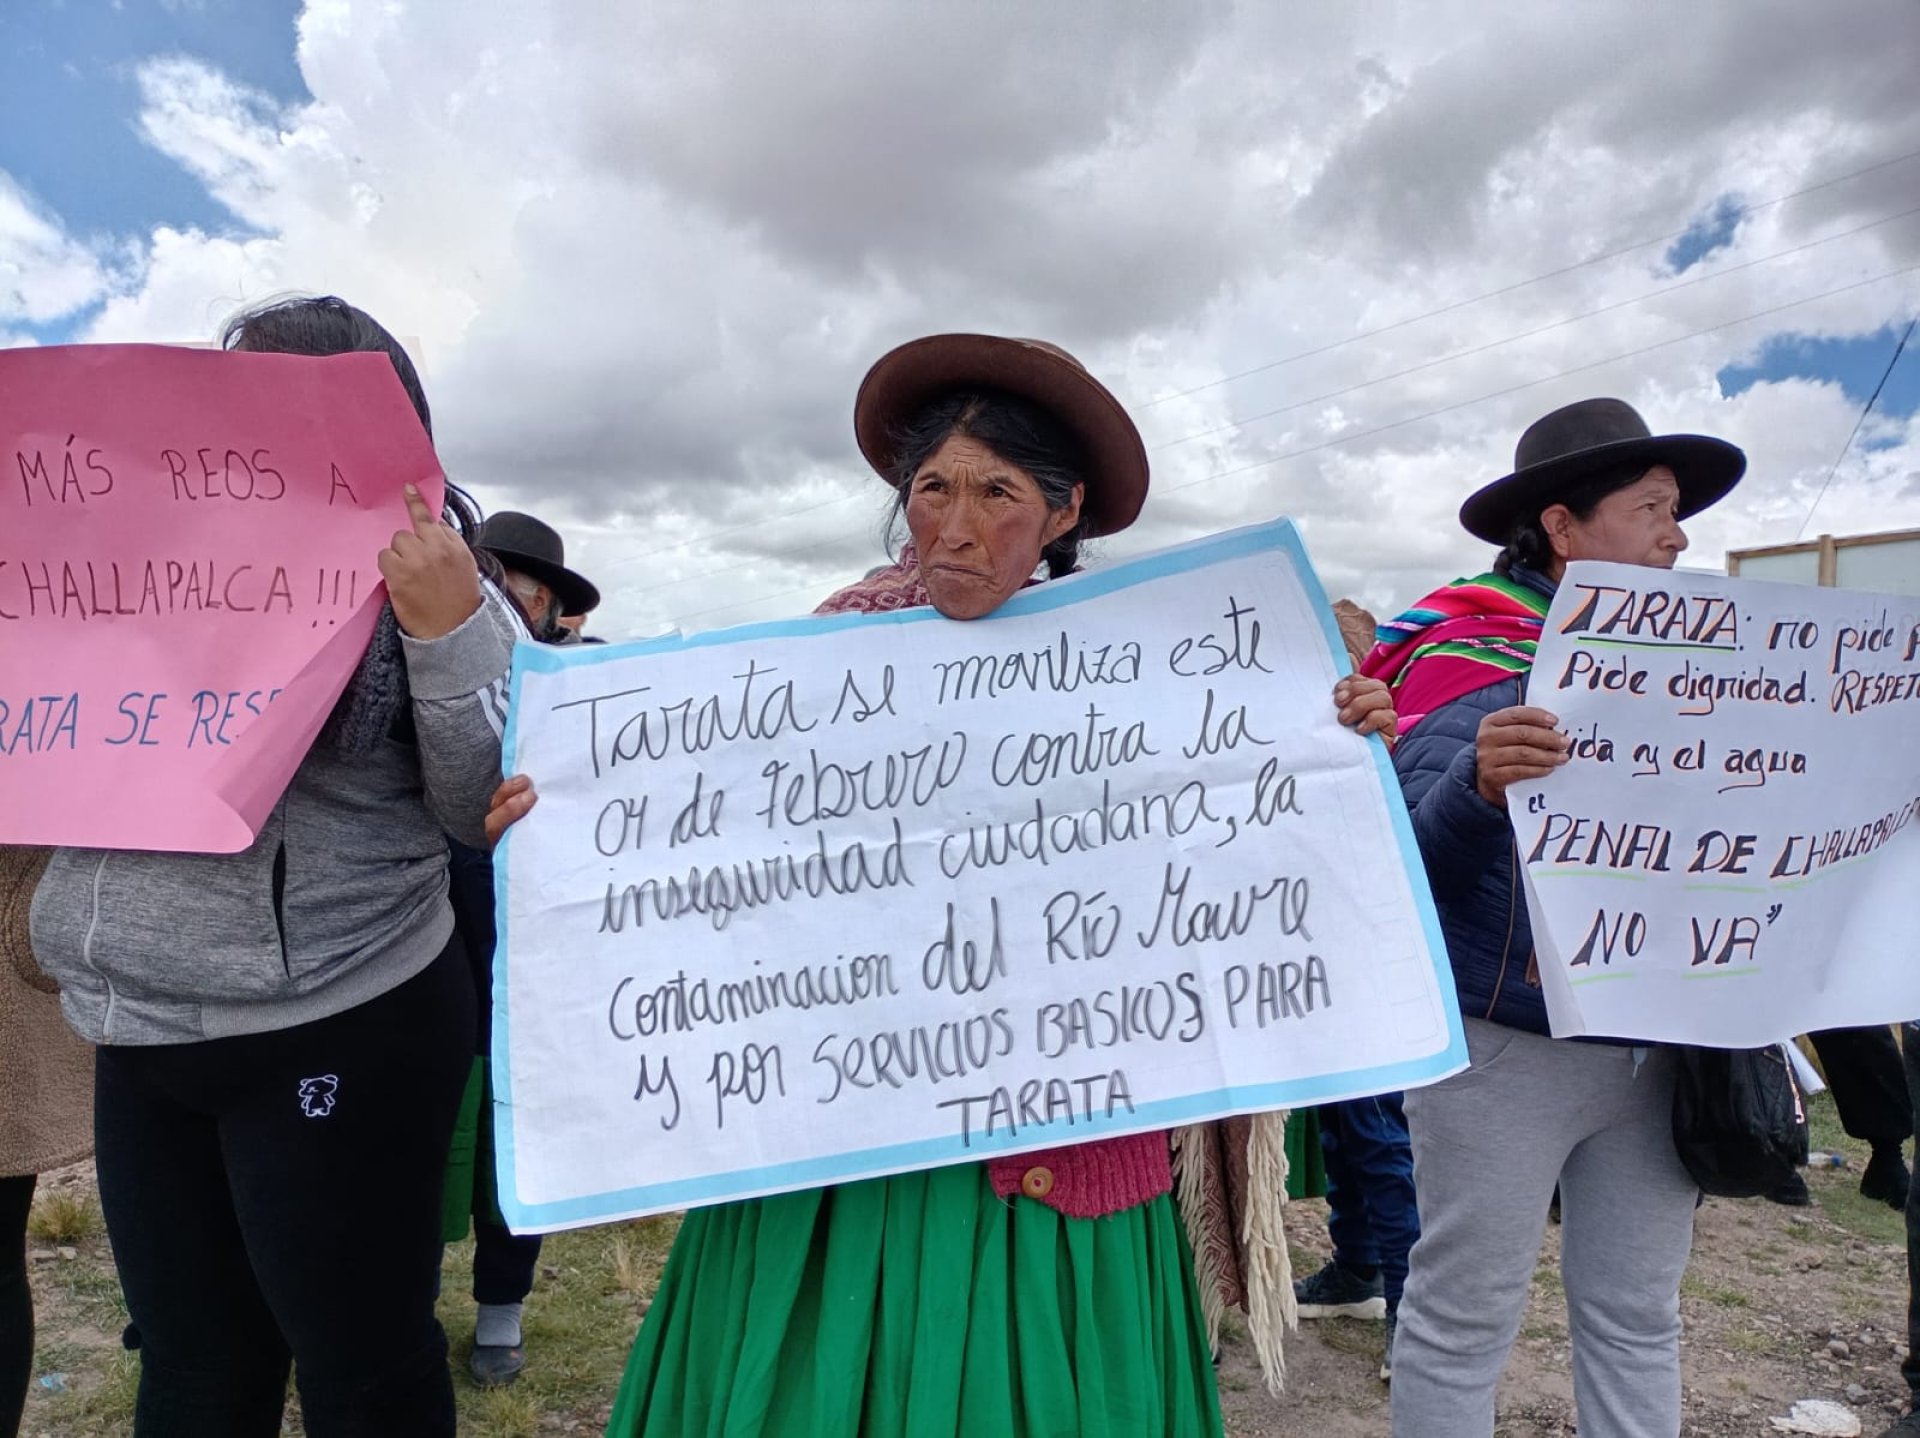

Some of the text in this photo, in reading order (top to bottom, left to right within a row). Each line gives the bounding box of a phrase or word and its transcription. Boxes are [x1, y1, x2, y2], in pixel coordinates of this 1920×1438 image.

[17, 433, 359, 506] MÁS REOS A
[1832, 608, 1894, 674] pide
[105, 692, 168, 747] SE
[187, 688, 283, 749] RES
[552, 596, 1274, 778] Tarata se moviliza este
[1558, 650, 1920, 716] Pide dignidad. RESPET
[594, 794, 648, 857] 04
[669, 772, 724, 848] de
[992, 702, 1160, 787] contra
[1183, 688, 1275, 760] la
[1563, 722, 1806, 793] ida y el agua
[598, 757, 1304, 932] inseguridad ciudadana, la
[1687, 830, 1757, 874] DE
[608, 950, 899, 1041] Contaminacion
[922, 897, 1007, 995] del
[1570, 908, 1647, 967] NO
[634, 1053, 681, 1131] y
[706, 1042, 786, 1130] por
[1036, 972, 1206, 1058] BASICOS
[1223, 954, 1333, 1030] PARA
[936, 1069, 1135, 1148] TARATA
